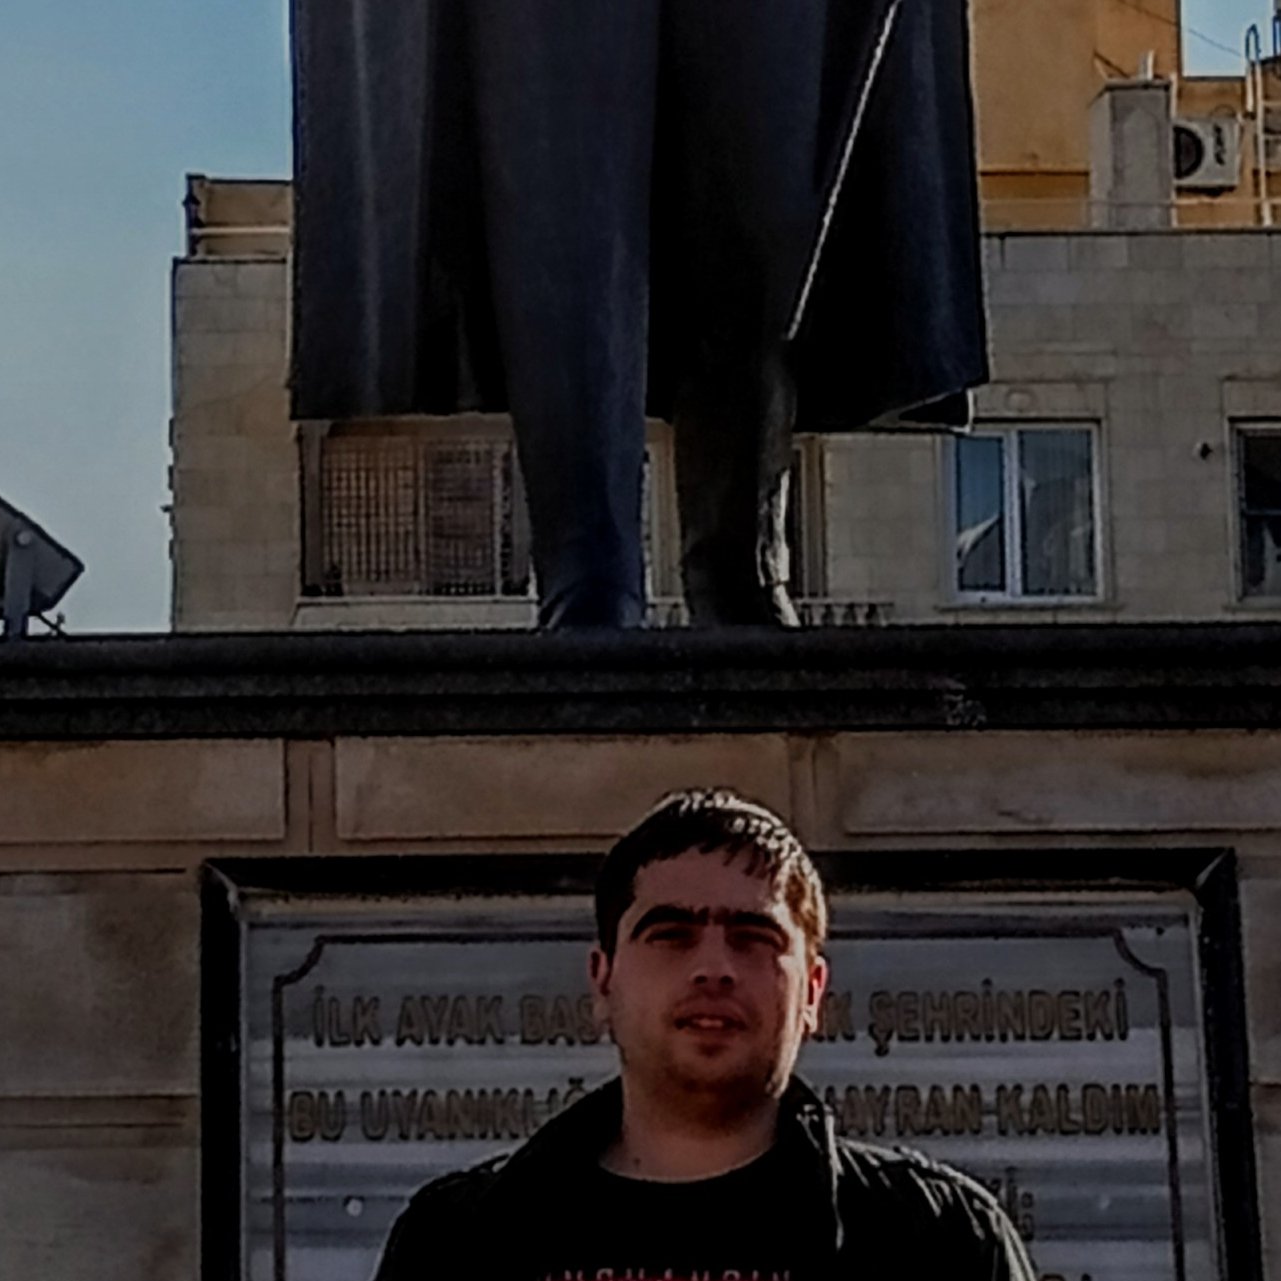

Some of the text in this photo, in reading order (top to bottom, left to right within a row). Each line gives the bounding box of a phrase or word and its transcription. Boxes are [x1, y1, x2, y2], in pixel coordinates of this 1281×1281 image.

[313, 985, 382, 1047] İLK
[396, 993, 505, 1047] AYAK
[869, 978, 1129, 1057] ŞEHRİNDEKİ
[288, 1089, 346, 1142] BU
[994, 1082, 1161, 1136] KALDIM
